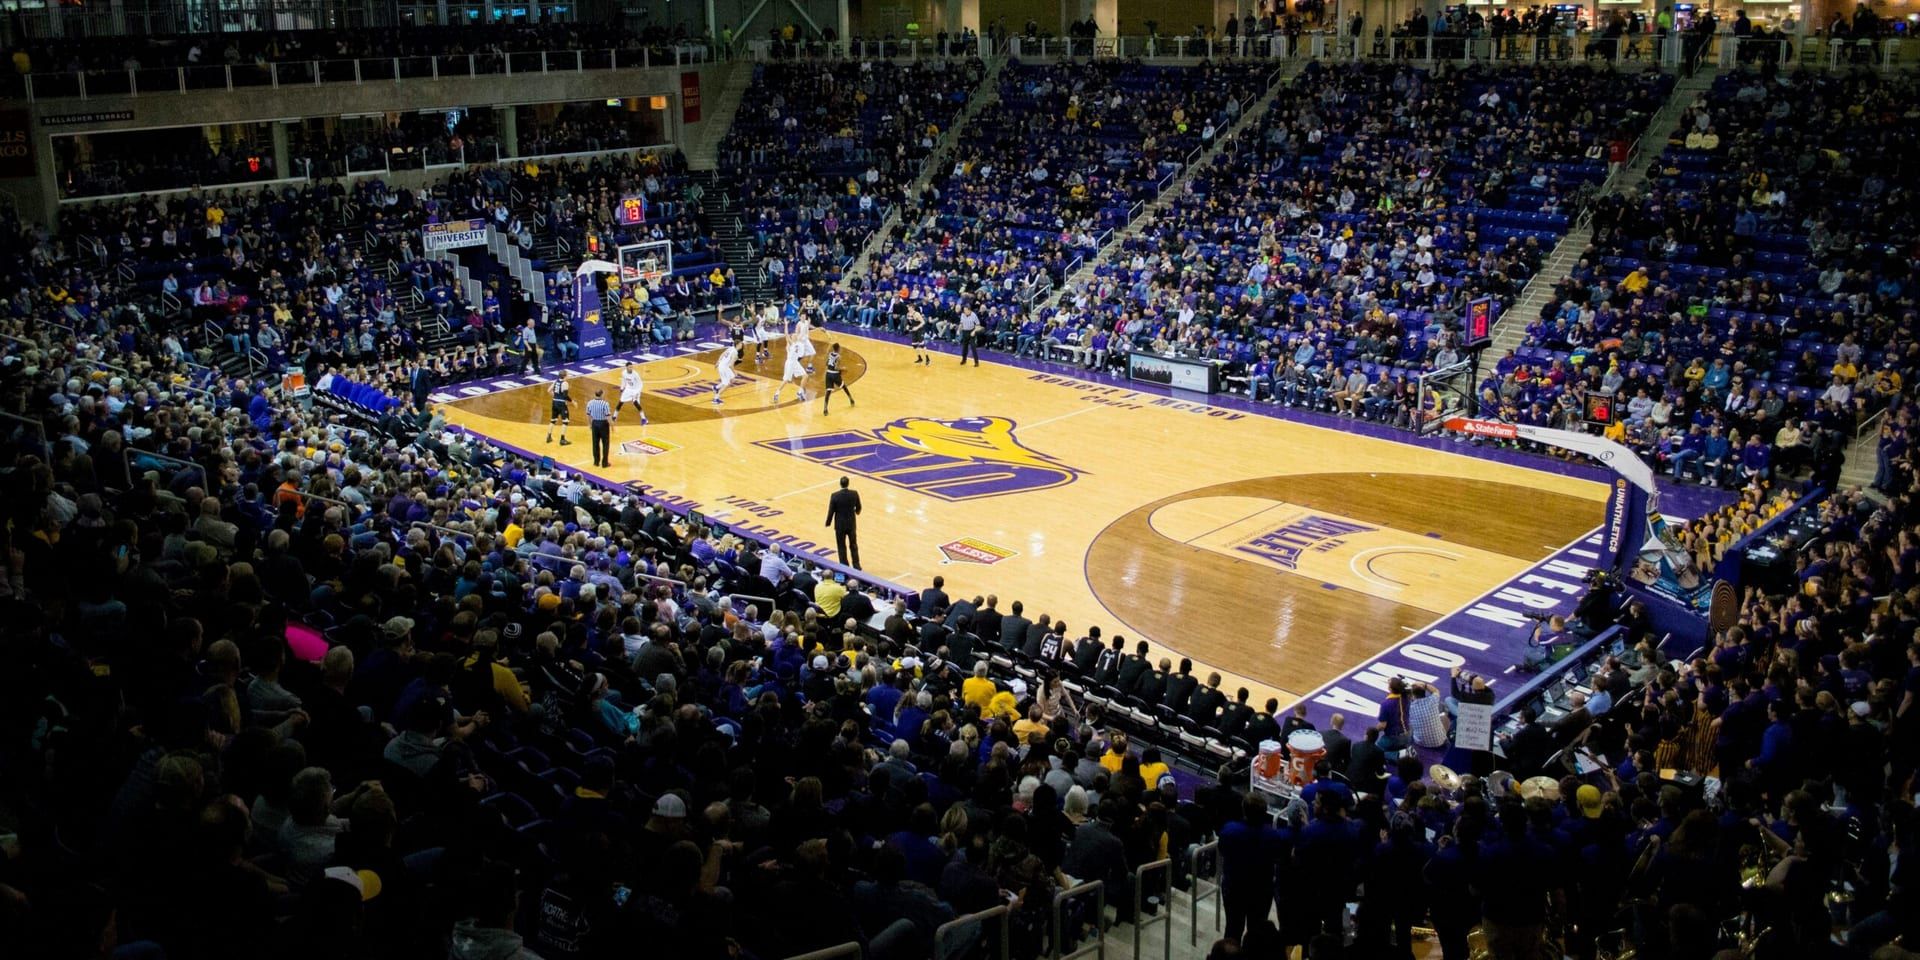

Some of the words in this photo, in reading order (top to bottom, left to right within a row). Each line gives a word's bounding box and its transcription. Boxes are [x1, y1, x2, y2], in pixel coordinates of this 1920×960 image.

[426, 230, 485, 250] UNIVERSITY
[1235, 515, 1379, 570] VALLEY
[1041, 644, 1058, 660] 24
[1293, 757, 1305, 771] G
